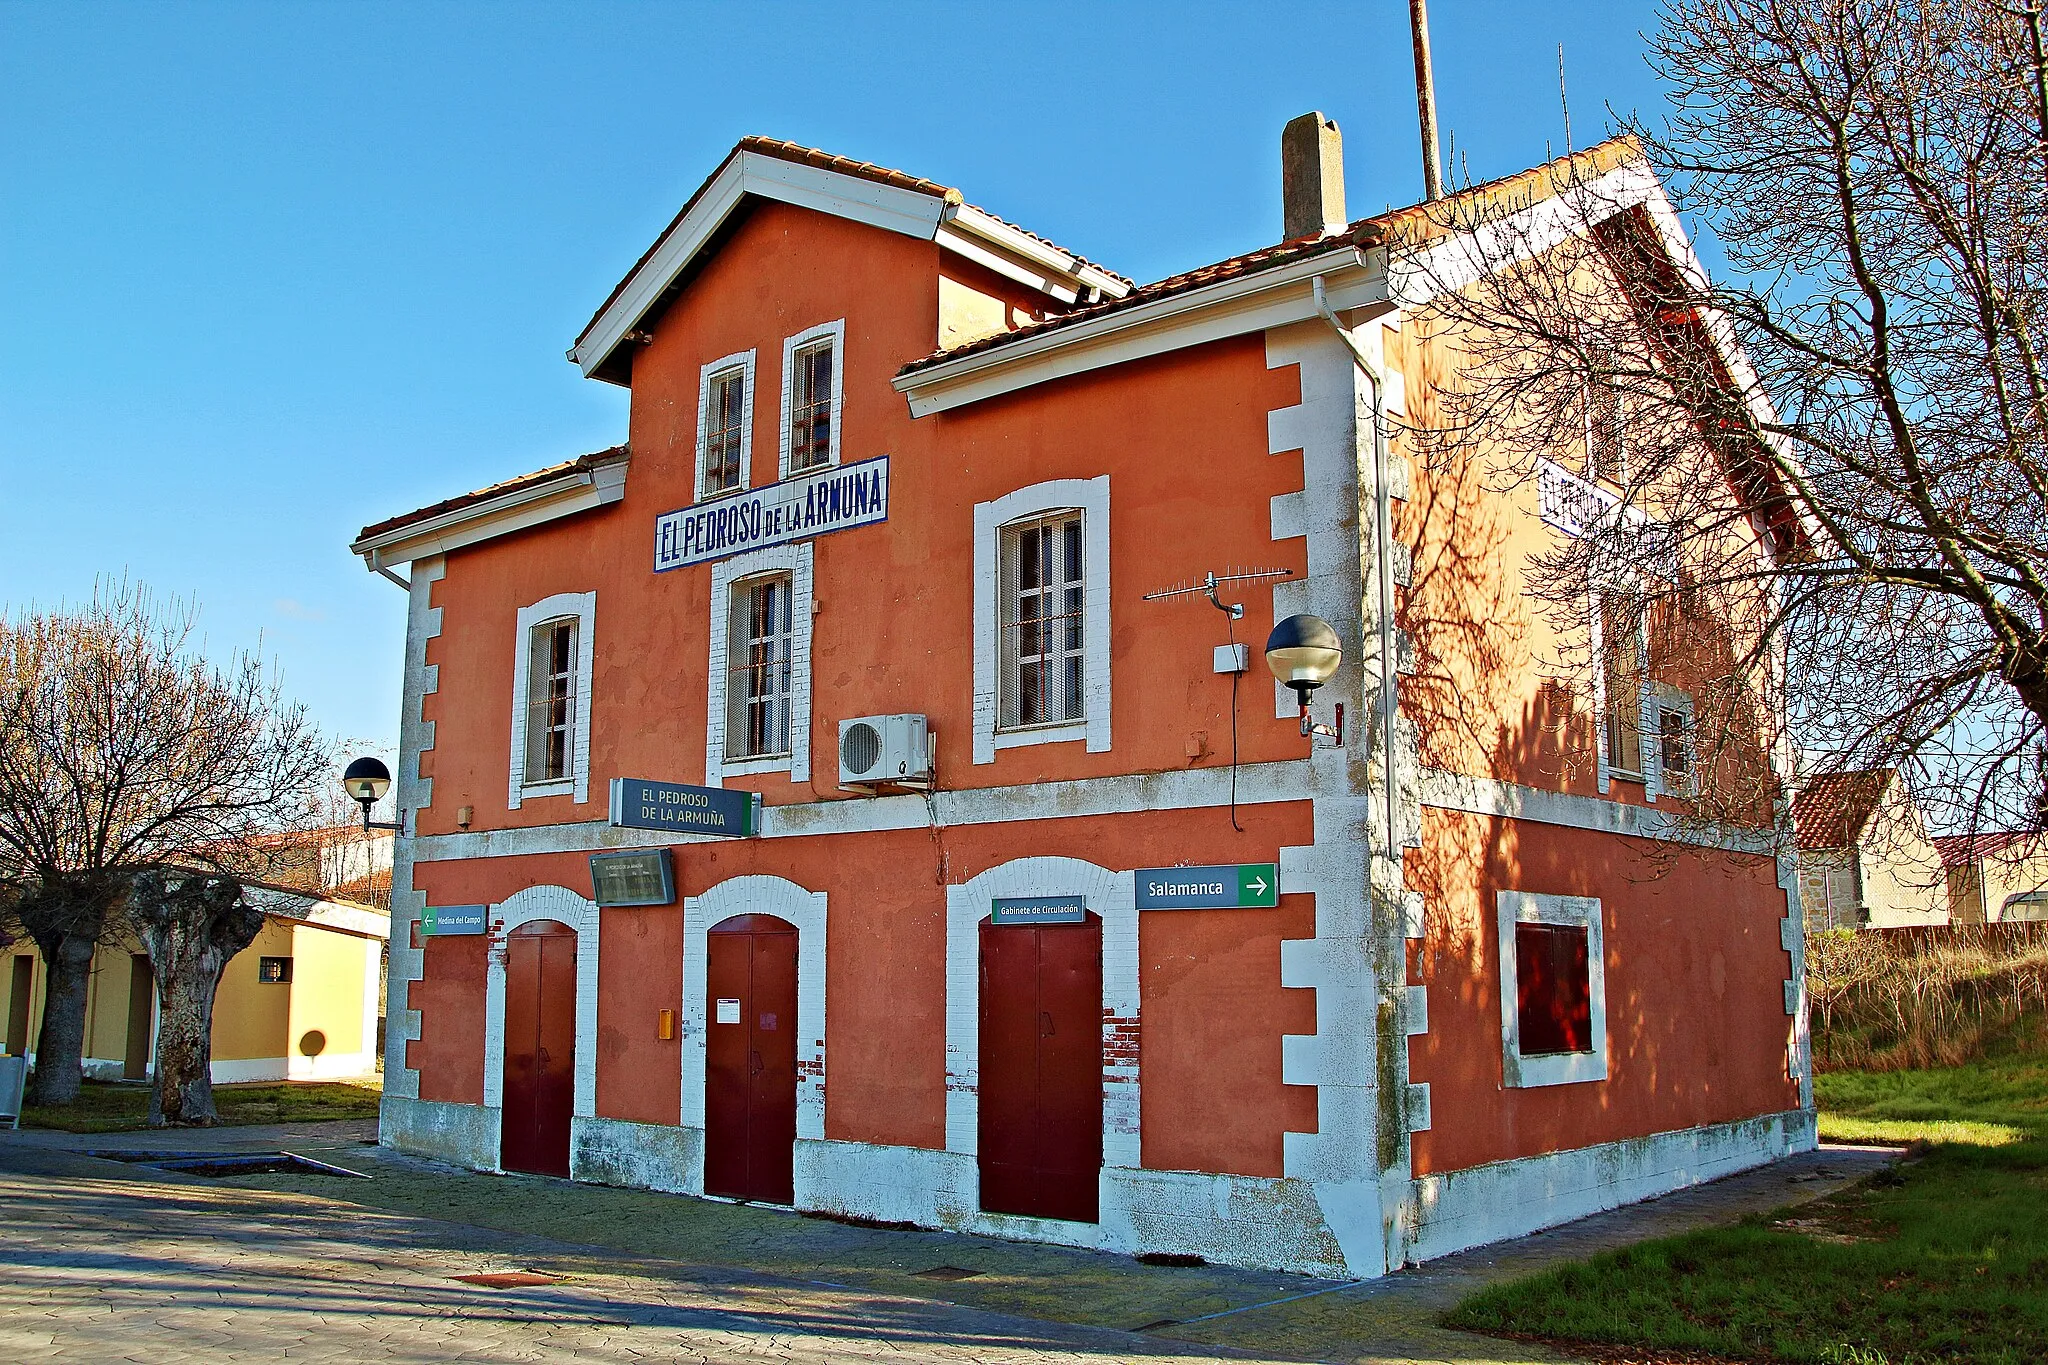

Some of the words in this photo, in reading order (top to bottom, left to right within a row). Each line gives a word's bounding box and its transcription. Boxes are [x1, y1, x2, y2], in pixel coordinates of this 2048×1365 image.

[661, 521, 680, 562] EL
[684, 499, 761, 557] PEDROSO
[765, 507, 782, 537] DE
[786, 502, 801, 533] LA
[804, 468, 882, 528] ARMUNA
[642, 788, 655, 802] EL
[659, 790, 708, 808] PEDROSO
[642, 806, 656, 820] DE
[661, 808, 674, 822] LA
[677, 809, 725, 826] ARMUÑA
[1148, 881, 1223, 897] Salamanca
[1000, 905, 1031, 915] Gabinete
[1032, 905, 1041, 914] de
[1042, 903, 1079, 914] Circulación
[437, 916, 455, 925] Medina
[455, 916, 464, 924] del
[464, 916, 481, 925] Campo
